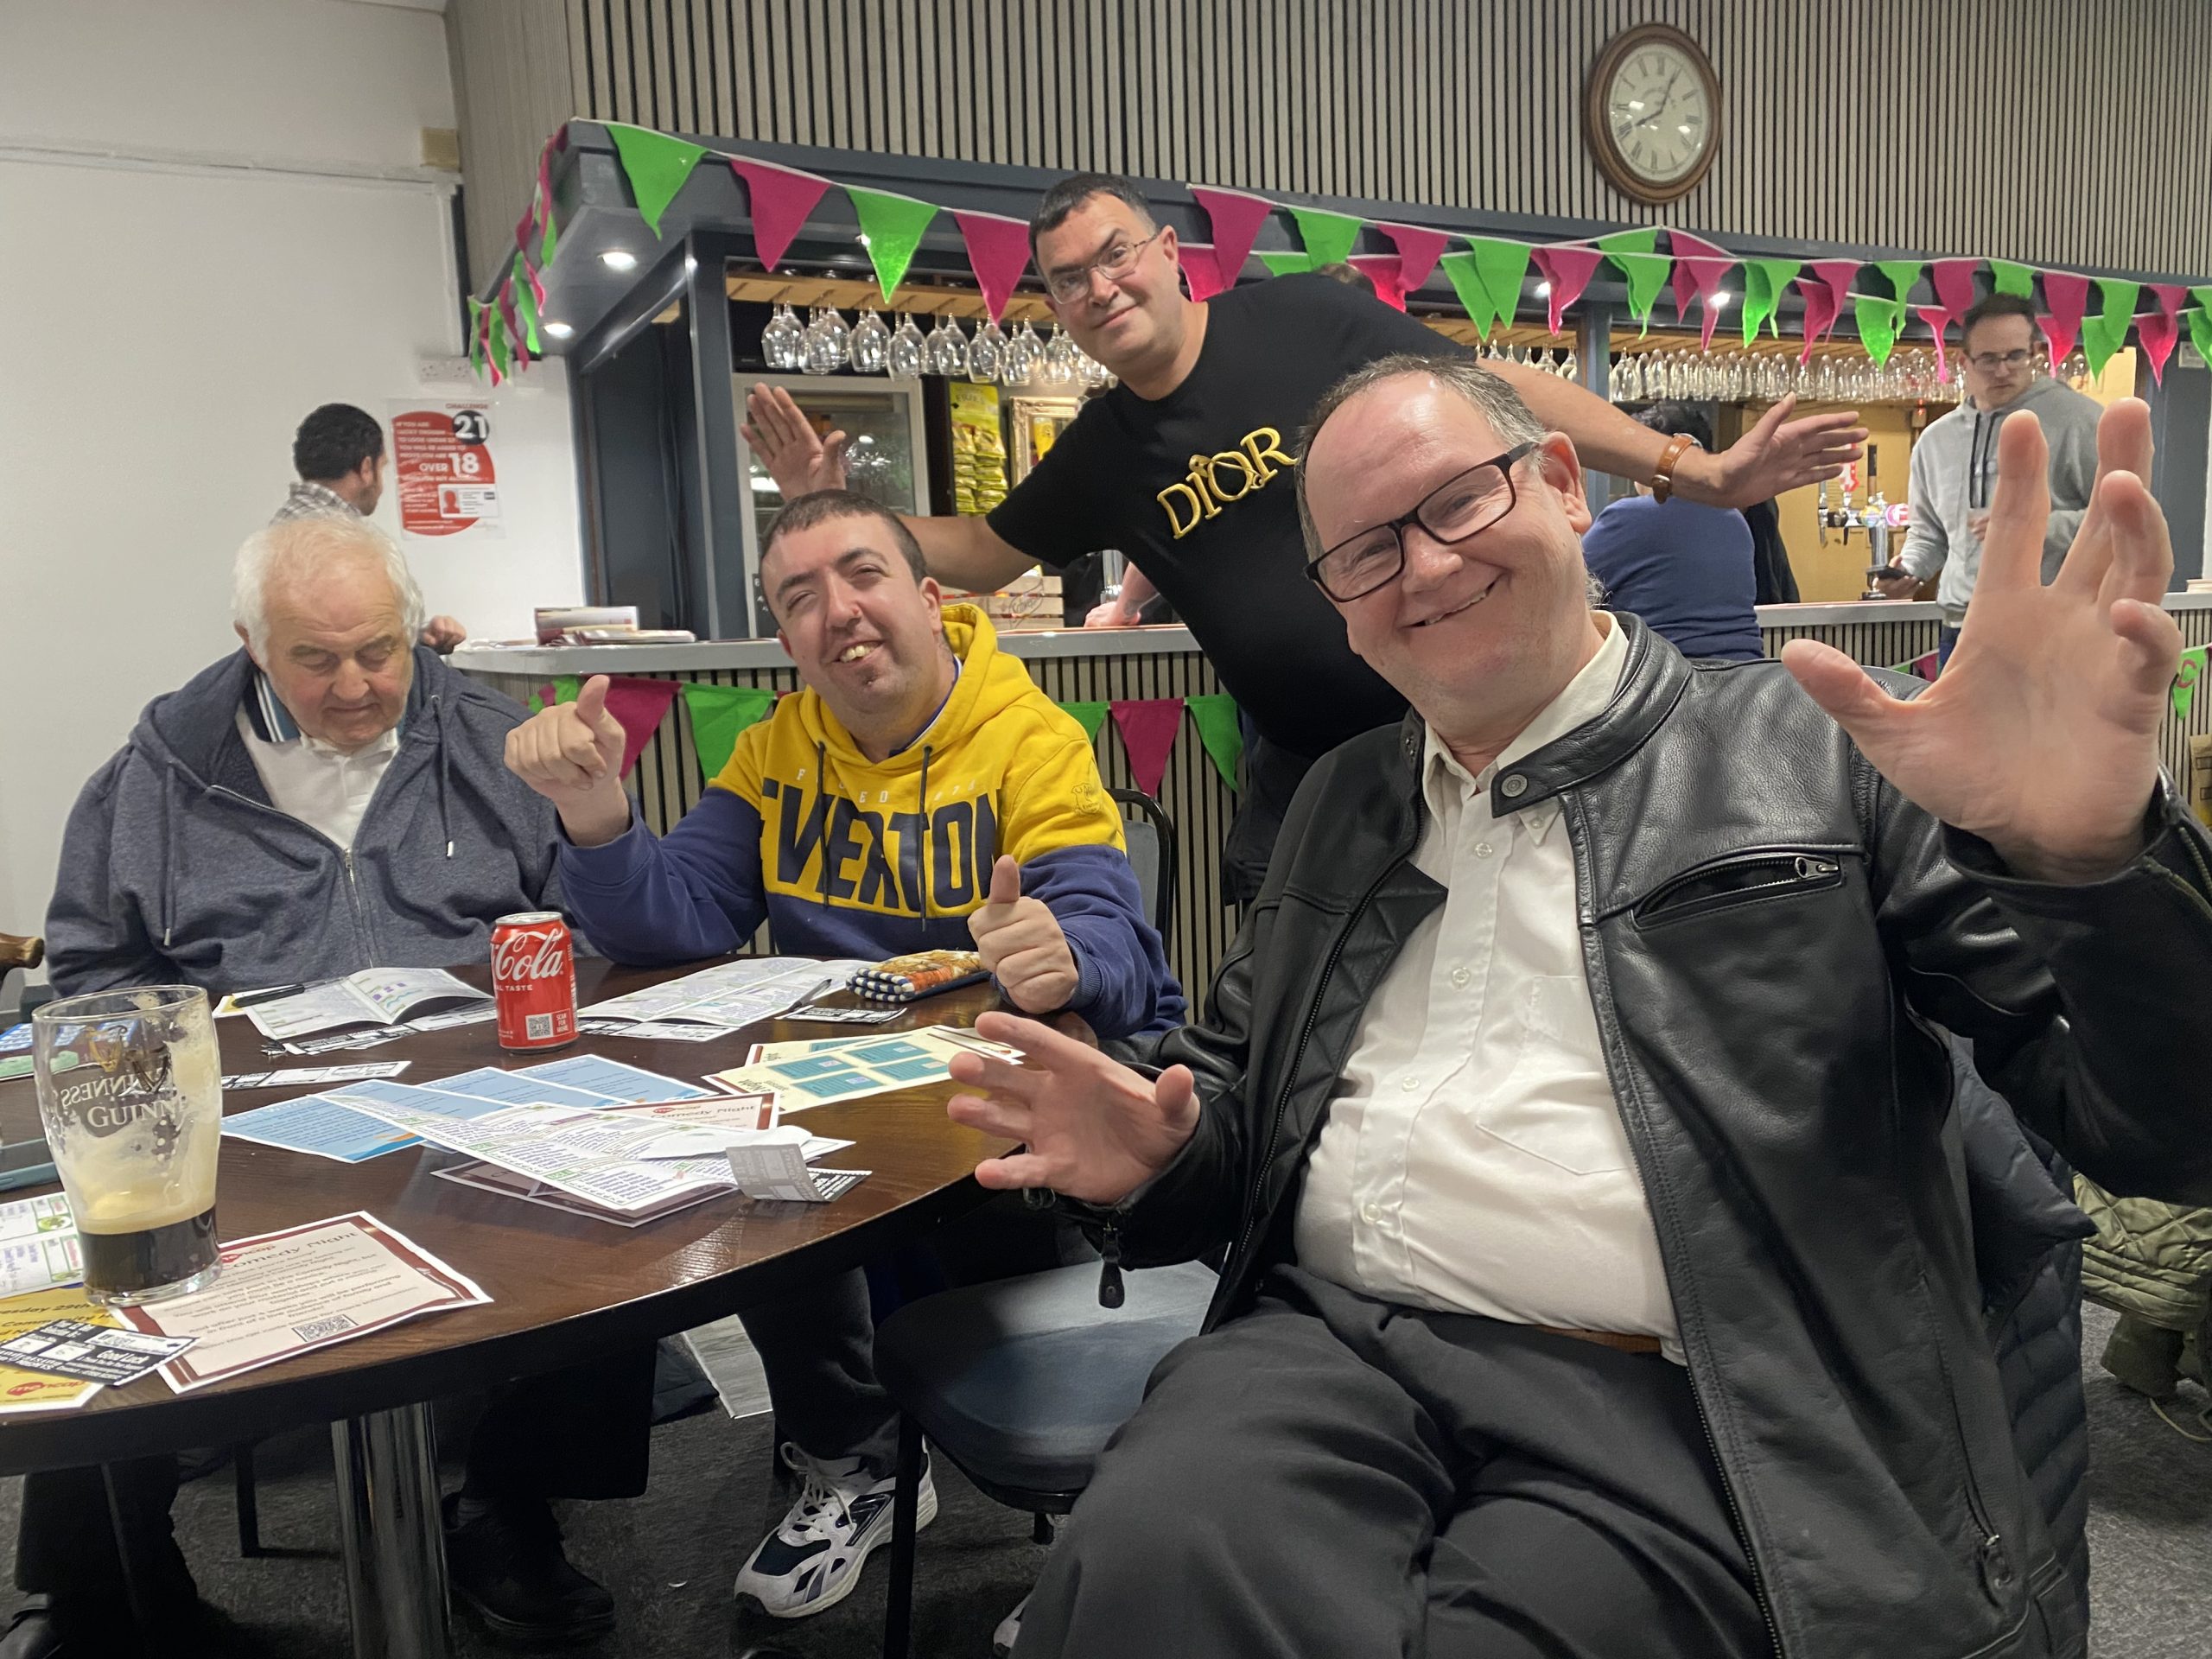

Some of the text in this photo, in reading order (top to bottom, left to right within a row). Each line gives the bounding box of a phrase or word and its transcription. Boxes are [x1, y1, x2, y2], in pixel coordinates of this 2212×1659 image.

[454, 415, 487, 439] 21
[419, 452, 480, 475] OVER 18
[1157, 427, 1297, 539] DIOR
[86, 1099, 188, 1128] GUINNE
[306, 1231, 359, 1249] Night
